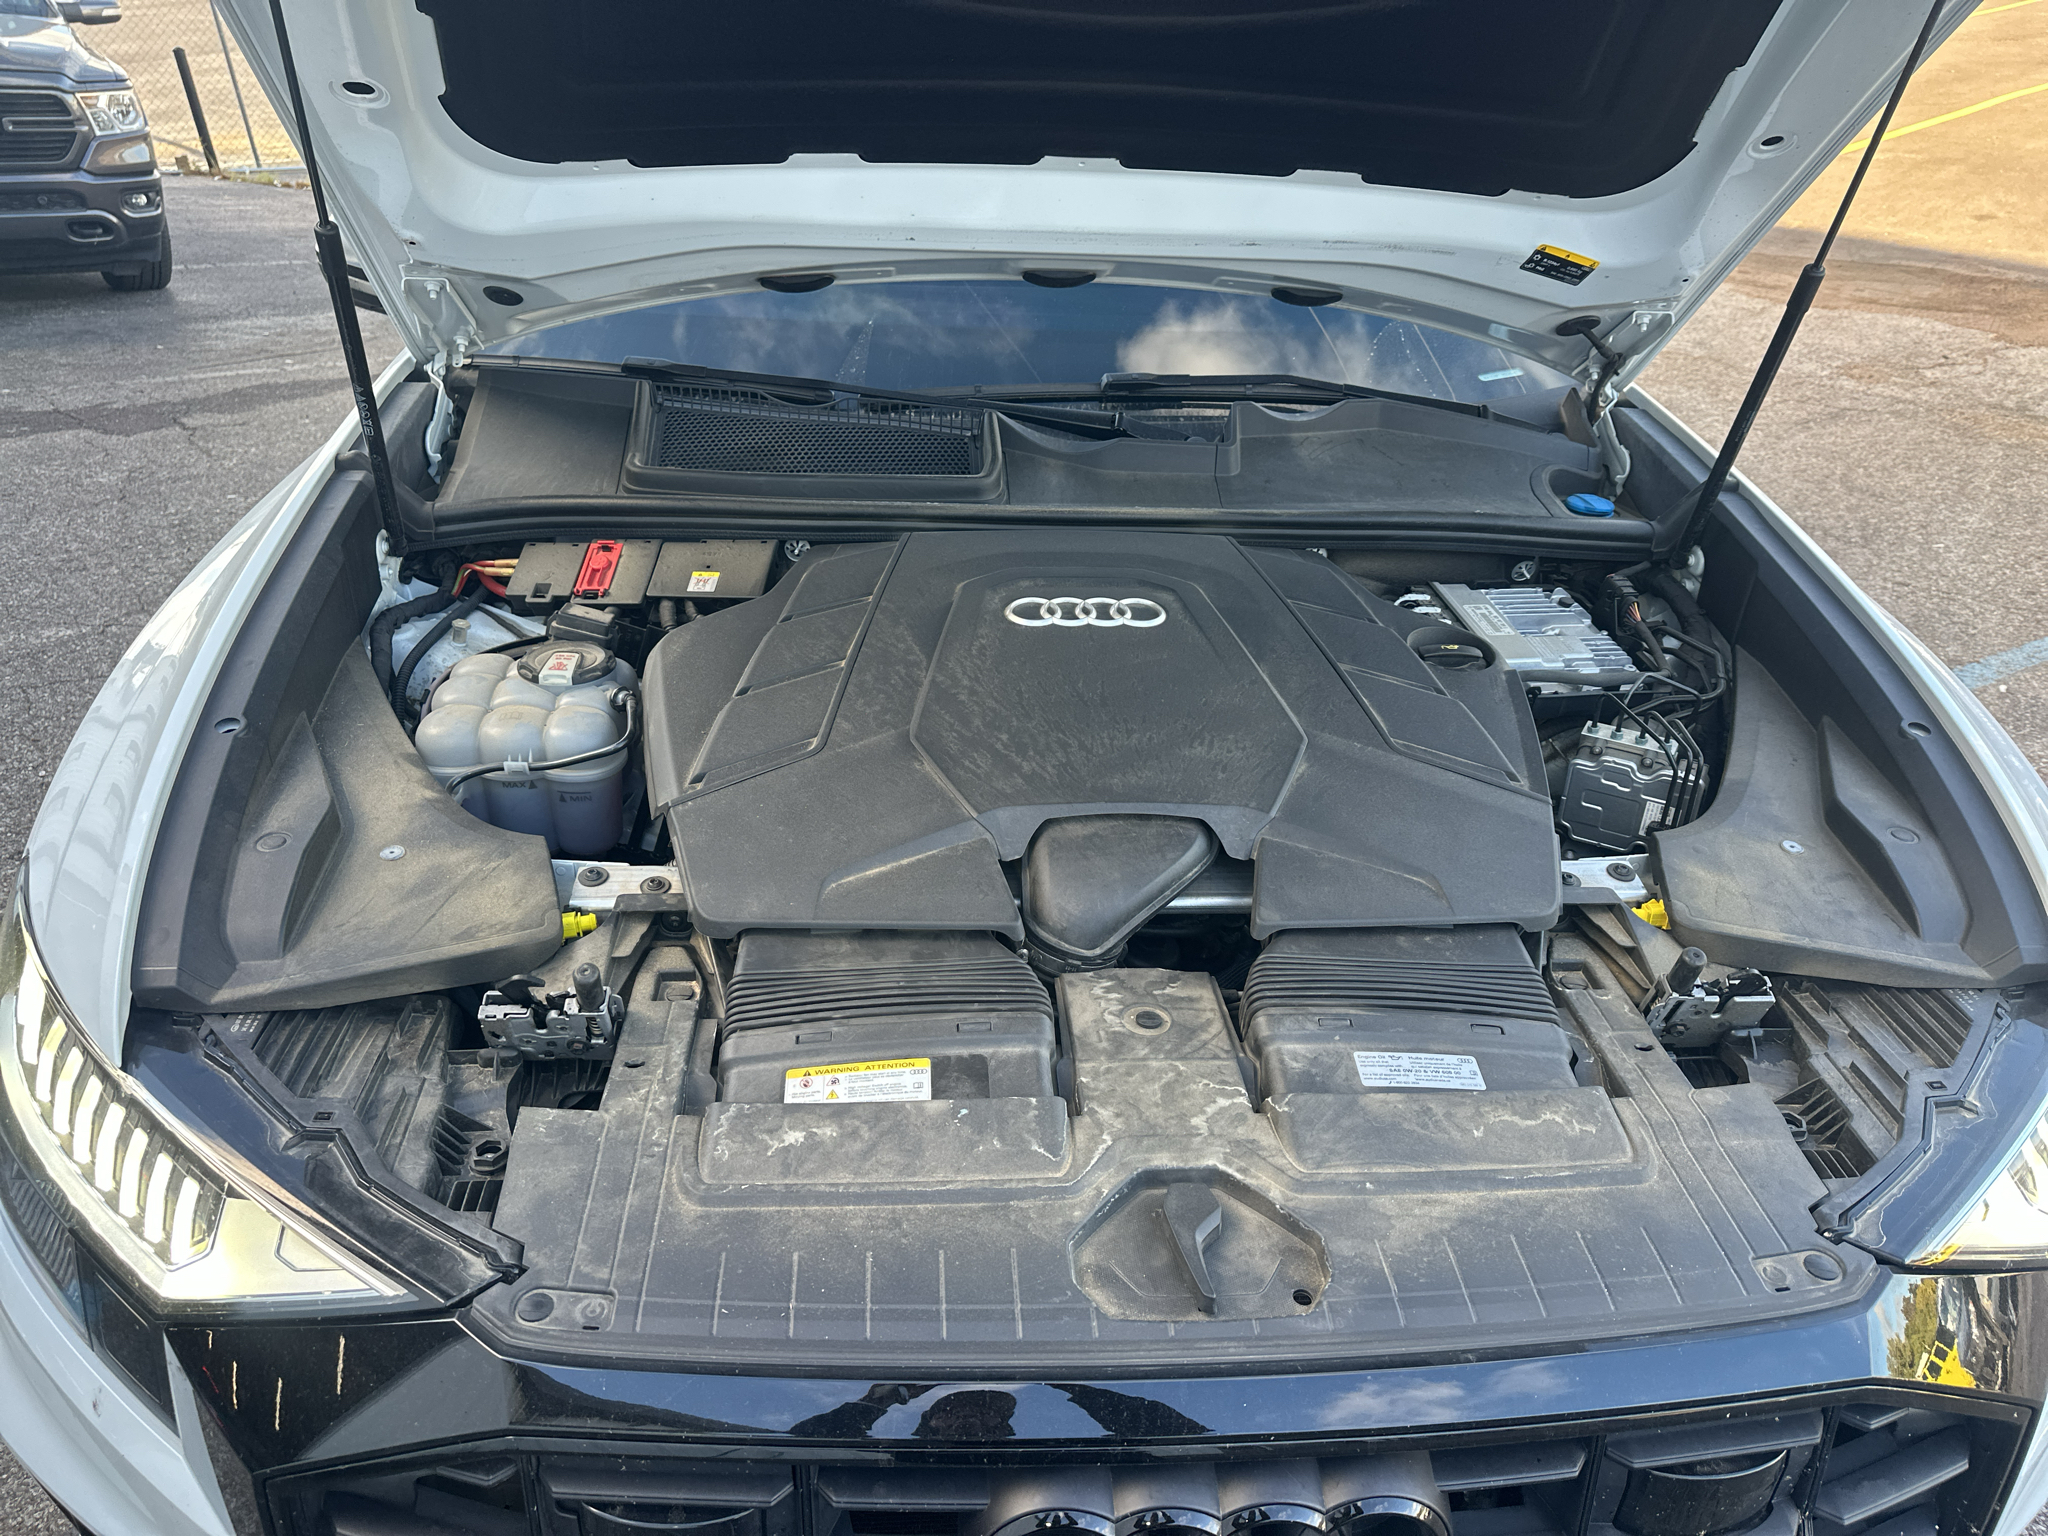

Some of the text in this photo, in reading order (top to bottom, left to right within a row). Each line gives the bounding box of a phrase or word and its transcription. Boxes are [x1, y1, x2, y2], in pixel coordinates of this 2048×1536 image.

[502, 781, 526, 789] MAX
[814, 1062, 915, 1075] WARNING ATTENTION
